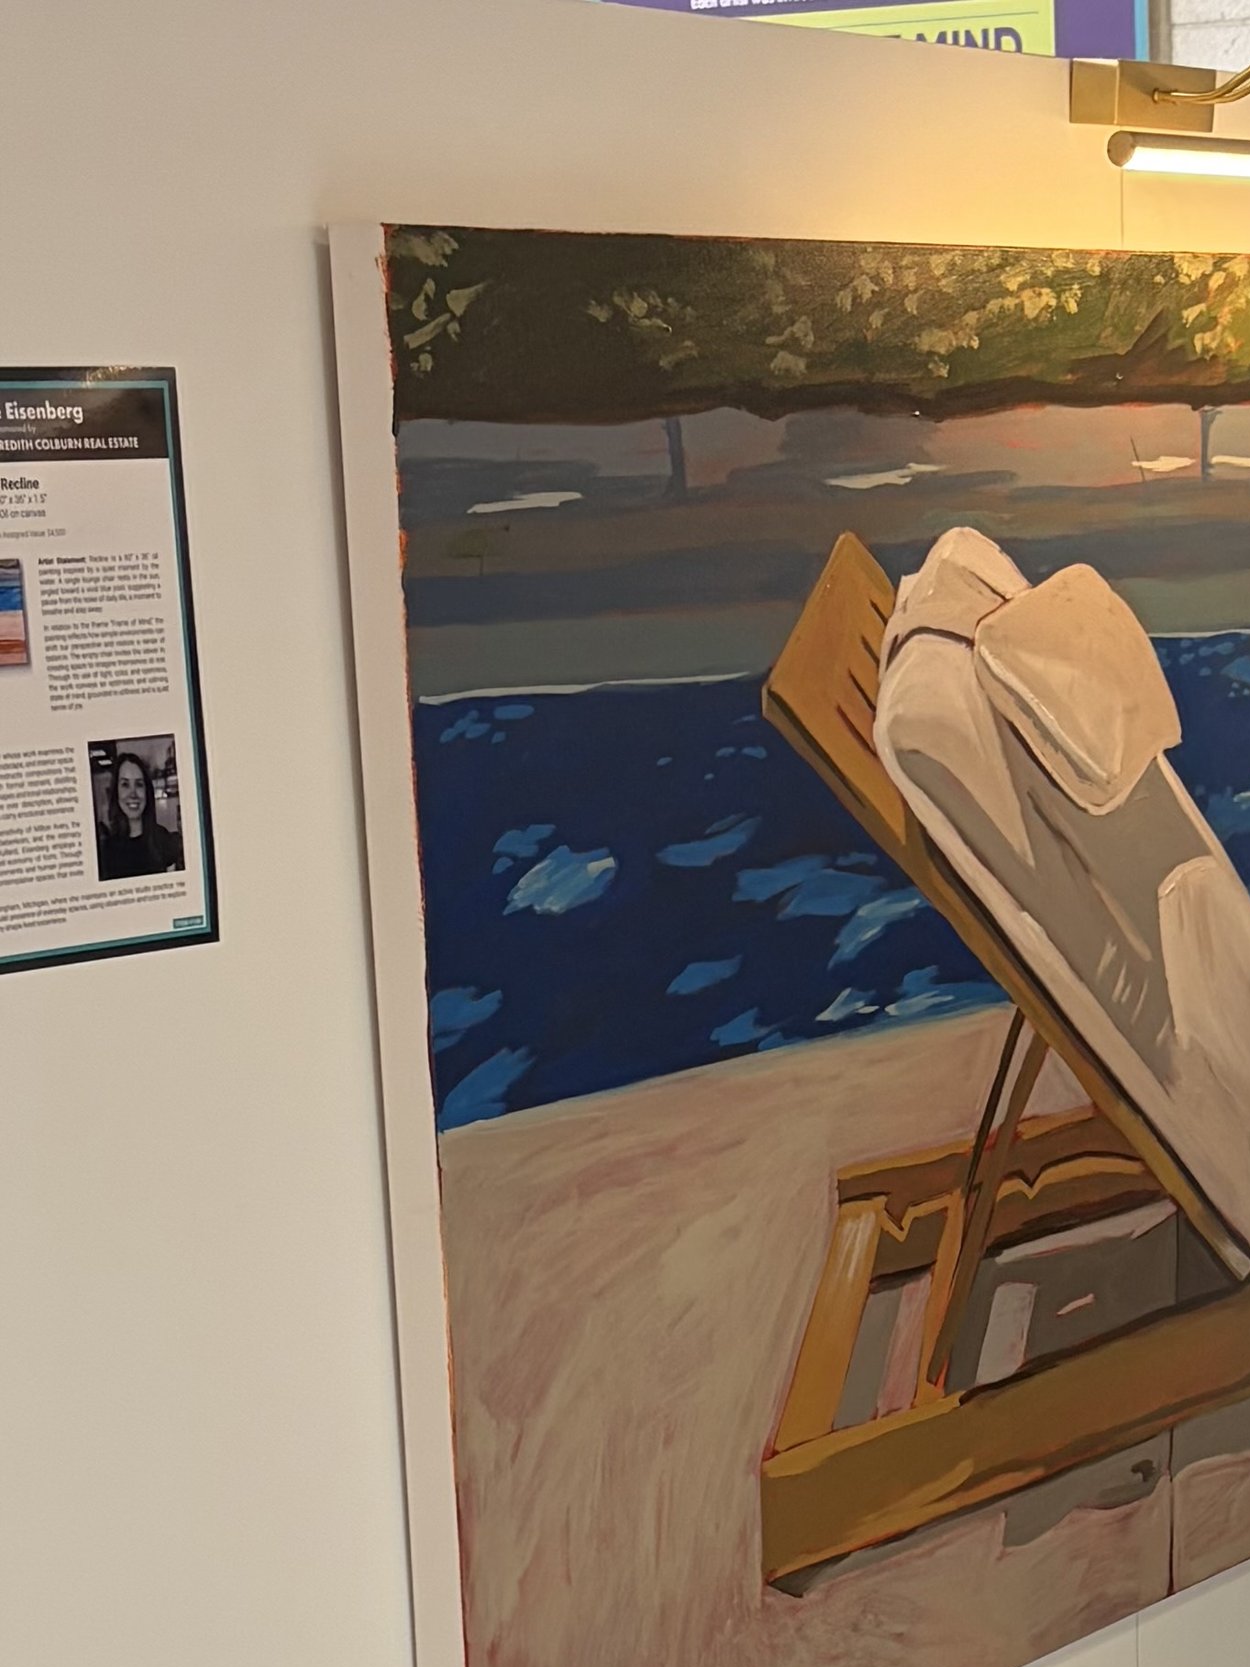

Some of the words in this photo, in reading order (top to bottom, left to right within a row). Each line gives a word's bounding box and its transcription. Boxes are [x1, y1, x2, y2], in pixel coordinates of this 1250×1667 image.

[4, 400, 84, 424] Eisenberg
[35, 438, 82, 450] COLBURN
[84, 438, 108, 450] REAL
[108, 436, 140, 448] ESTATE
[1, 477, 40, 491] Recline
